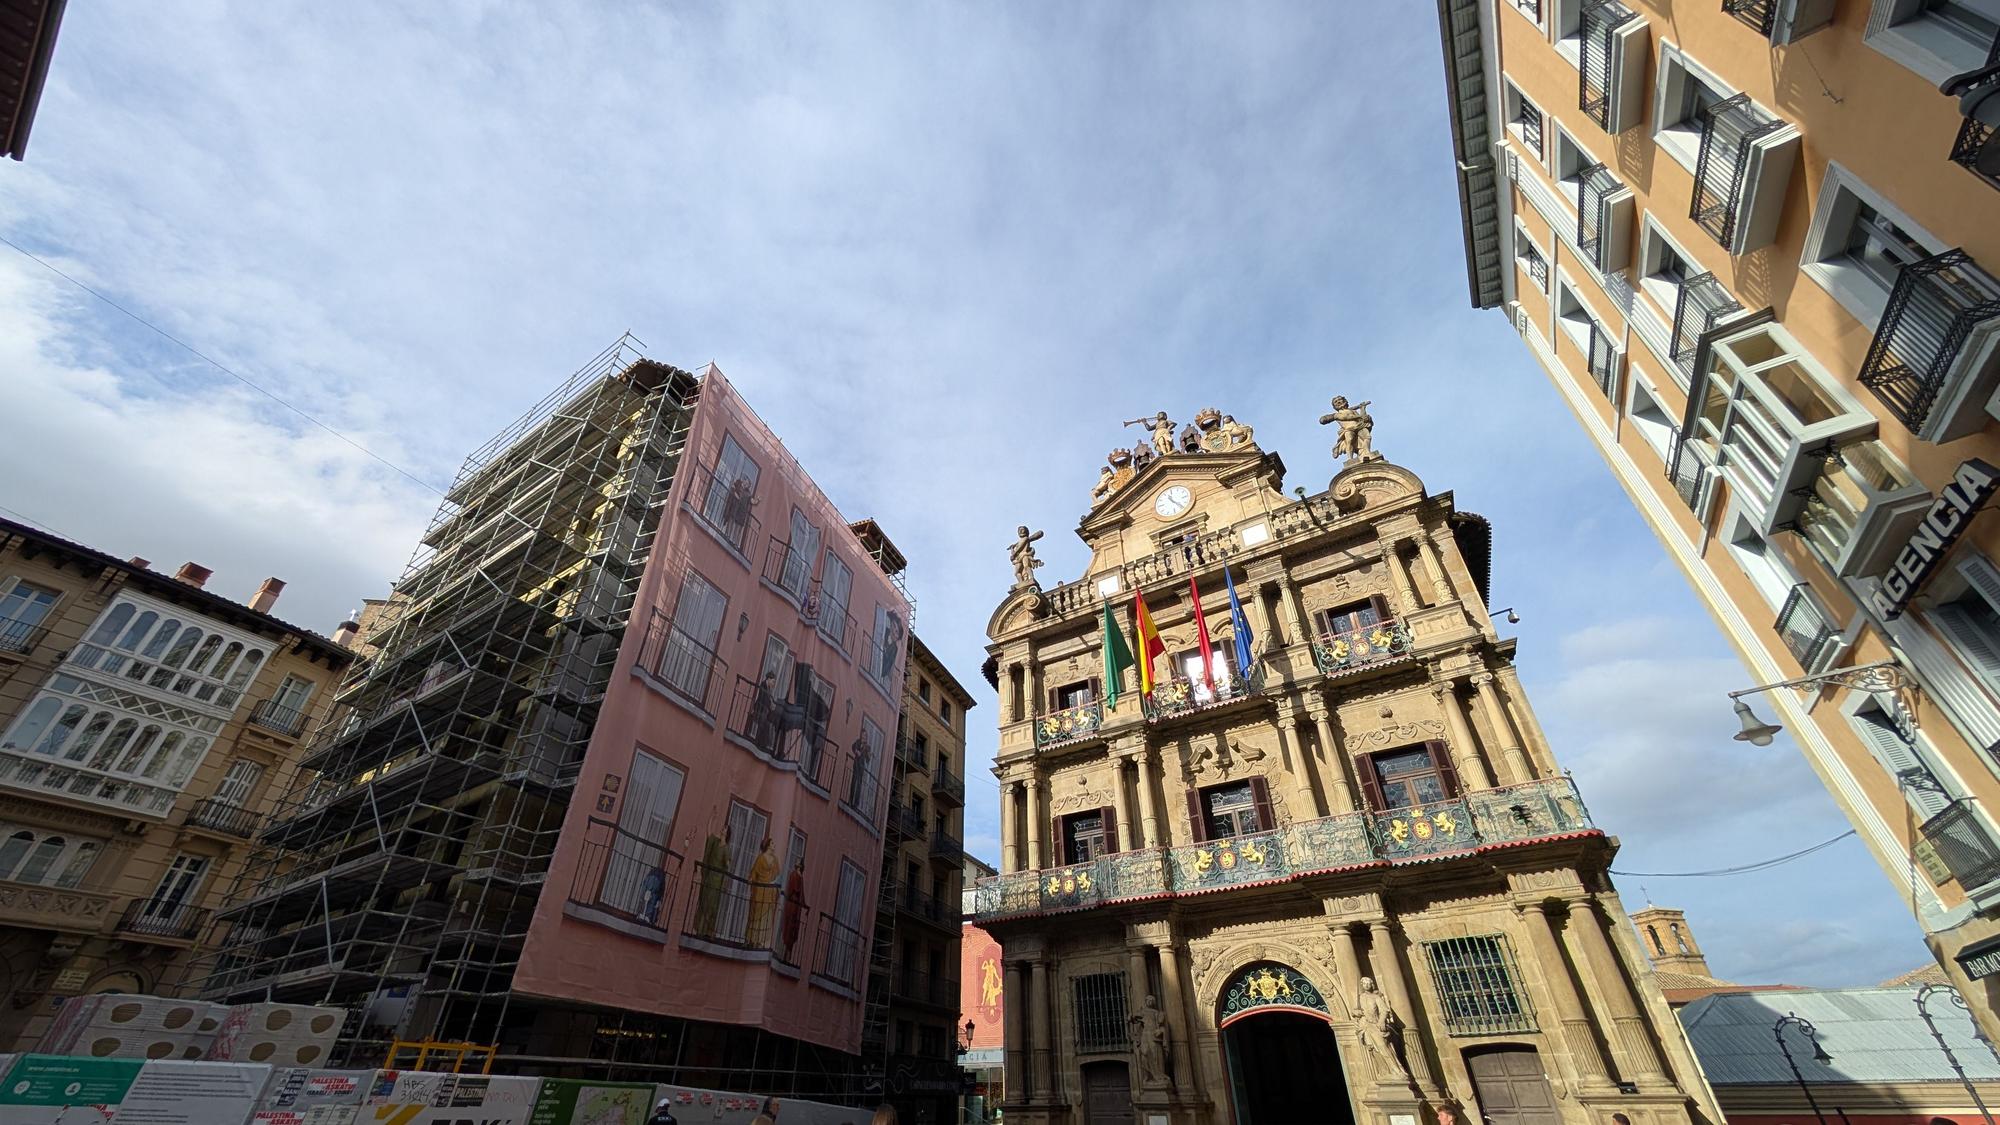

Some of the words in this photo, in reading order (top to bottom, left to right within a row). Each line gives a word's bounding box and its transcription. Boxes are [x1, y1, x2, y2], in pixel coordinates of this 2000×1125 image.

[1872, 461, 1993, 621] AGENCIA
[1966, 957, 1991, 978] BAR
[1983, 951, 2000, 973] MO
[256, 1111, 296, 1119] PALESTINA
